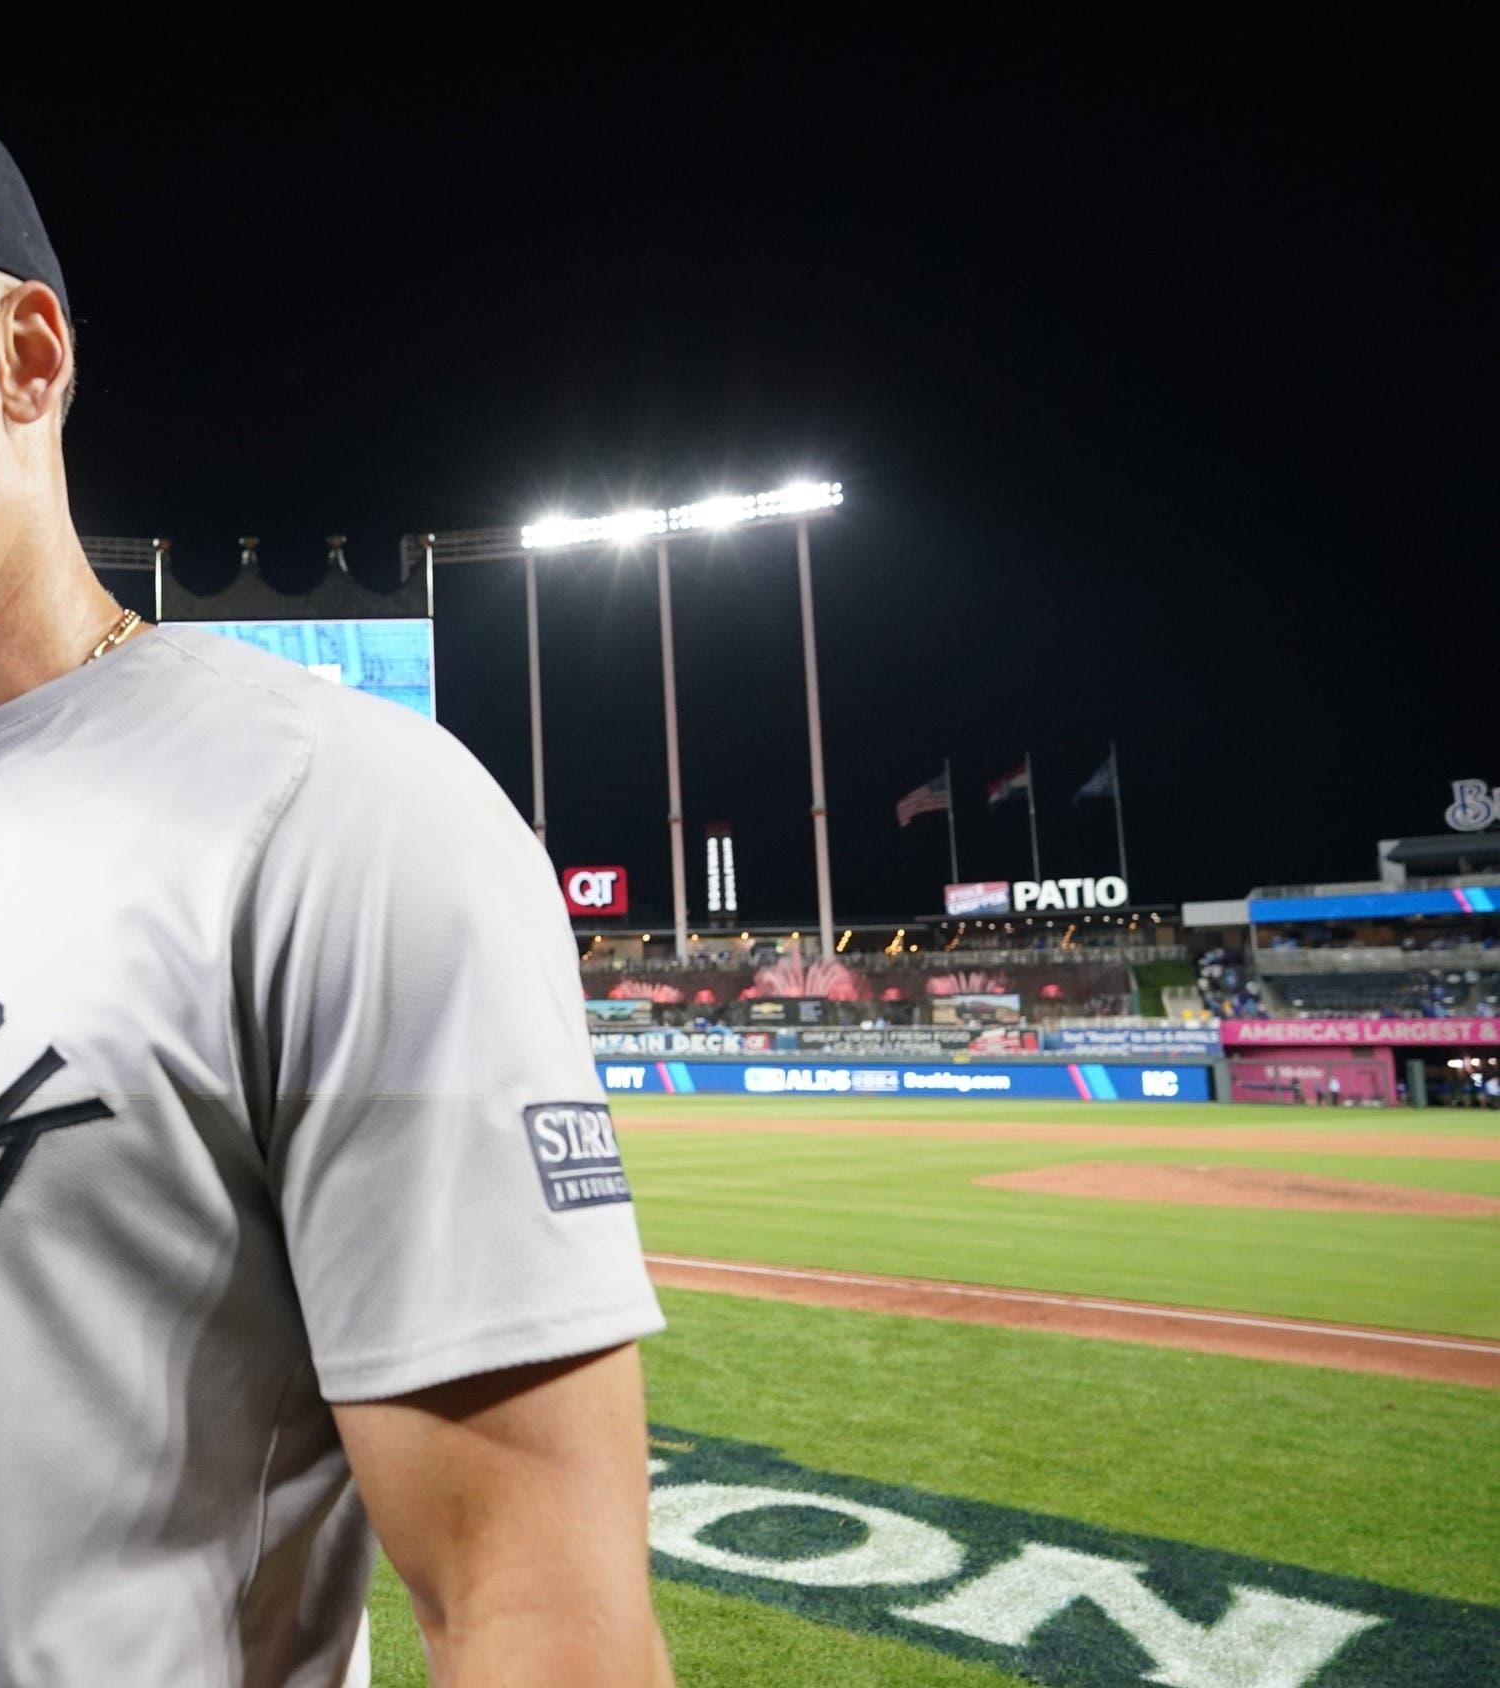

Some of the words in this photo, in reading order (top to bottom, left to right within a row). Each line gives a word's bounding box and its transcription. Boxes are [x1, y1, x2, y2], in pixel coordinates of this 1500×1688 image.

[1445, 778, 1500, 831] B
[568, 870, 618, 907] QT
[1013, 875, 1129, 912] PATIO
[1238, 1022, 1360, 1042] AMERICA'S
[1363, 1022, 1471, 1042] LARGEST
[786, 1069, 852, 1092] ALDS
[647, 1459, 1386, 1688] ON
